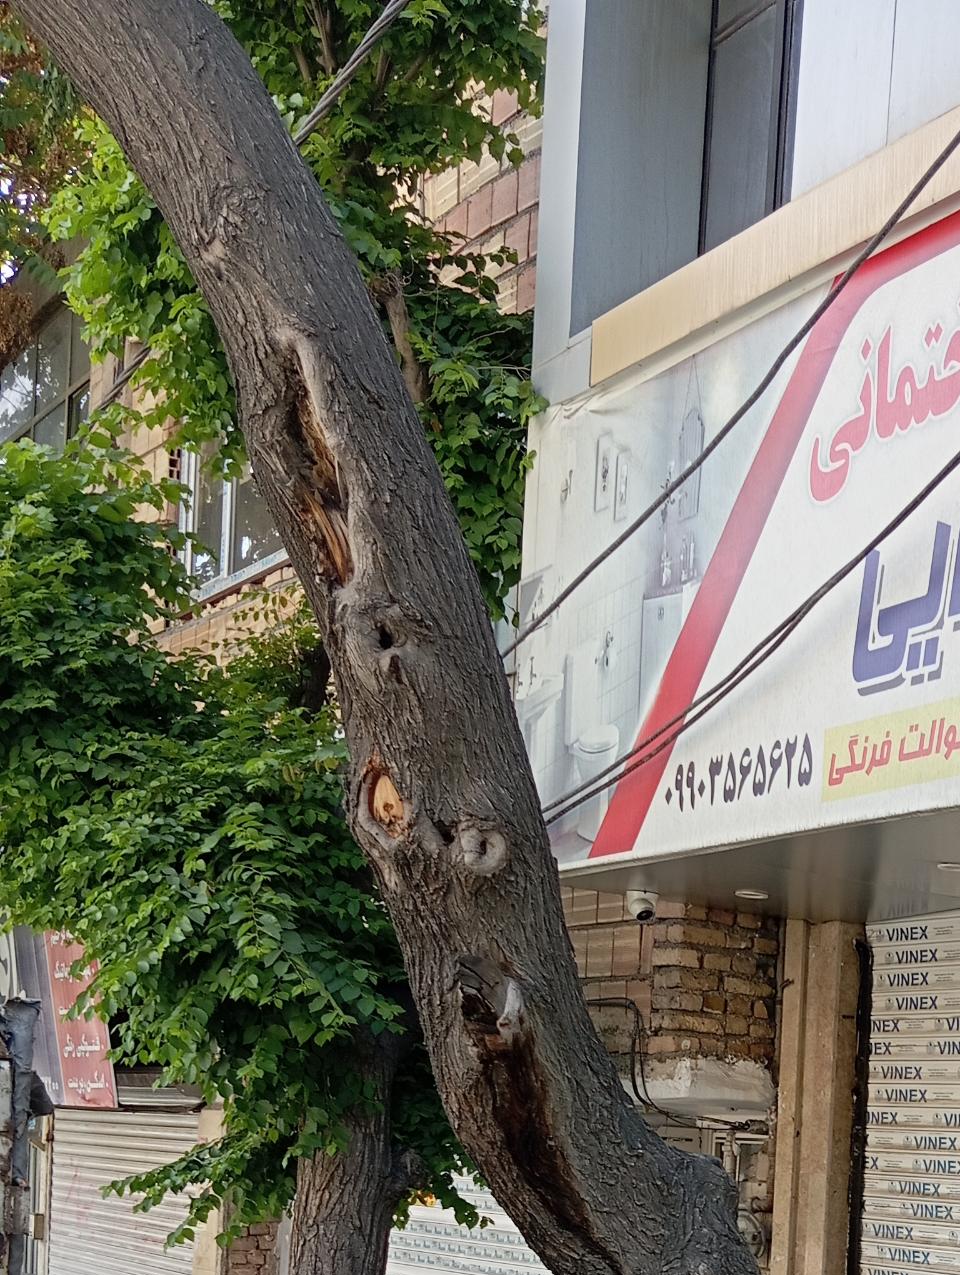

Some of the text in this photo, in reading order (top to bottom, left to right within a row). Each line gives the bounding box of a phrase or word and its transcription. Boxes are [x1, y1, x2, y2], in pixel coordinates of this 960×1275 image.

[665, 733, 813, 812] ۰۹۹۰۳۵۶۵۶۲۵
[886, 925, 928, 941] VINEX
[895, 948, 937, 964] VINEX
[887, 972, 928, 987] VINEX
[895, 996, 937, 1010] VINEX
[880, 1066, 922, 1079] VINEX
[885, 1089, 926, 1102] VINEX
[914, 1136, 957, 1151] VINEX
[898, 1180, 940, 1197] VINEX
[910, 1203, 953, 1220] VINEX
[872, 1223, 913, 1240] VINEX
[888, 1247, 930, 1265] VINEX
